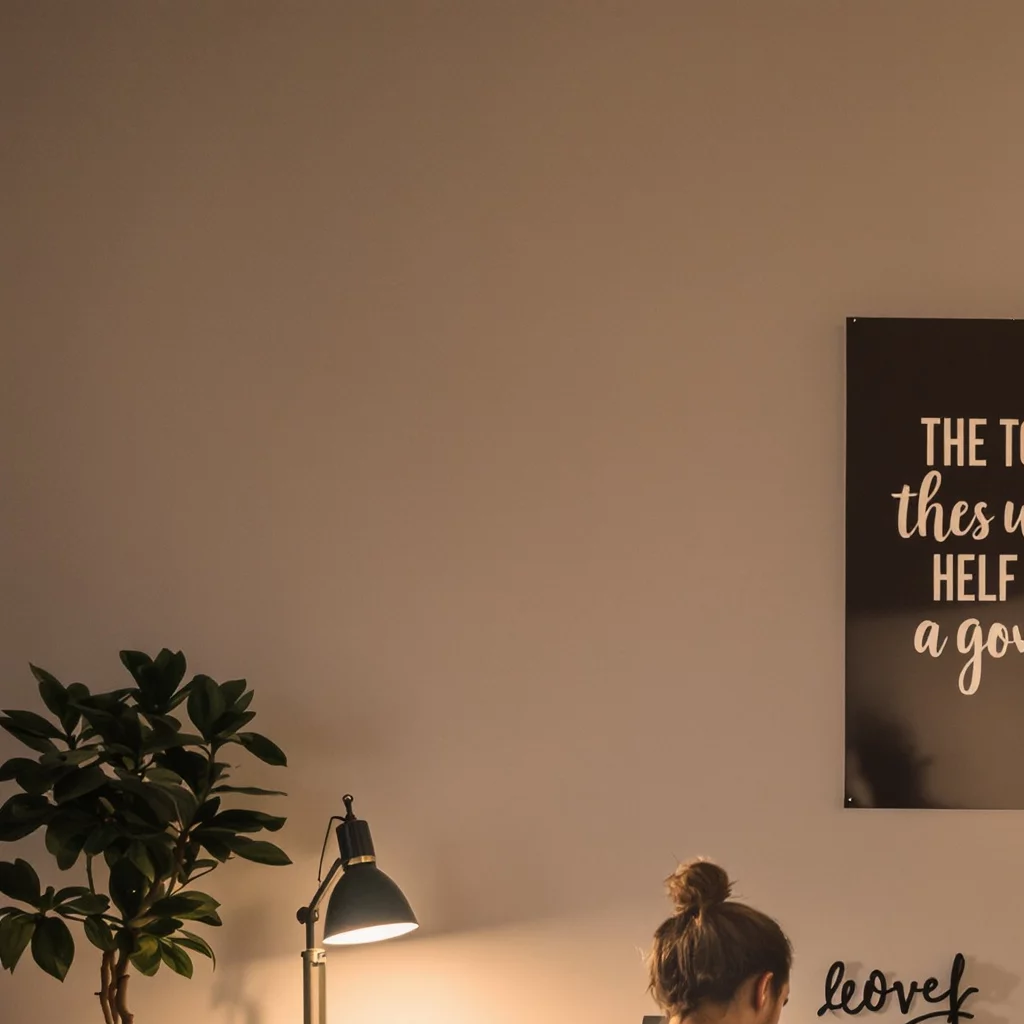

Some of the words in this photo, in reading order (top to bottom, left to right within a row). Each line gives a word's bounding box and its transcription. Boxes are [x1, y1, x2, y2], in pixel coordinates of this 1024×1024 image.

[920, 417, 987, 467] THE
[891, 470, 994, 542] thes
[933, 553, 1018, 602] HELF
[913, 619, 949, 659] a
